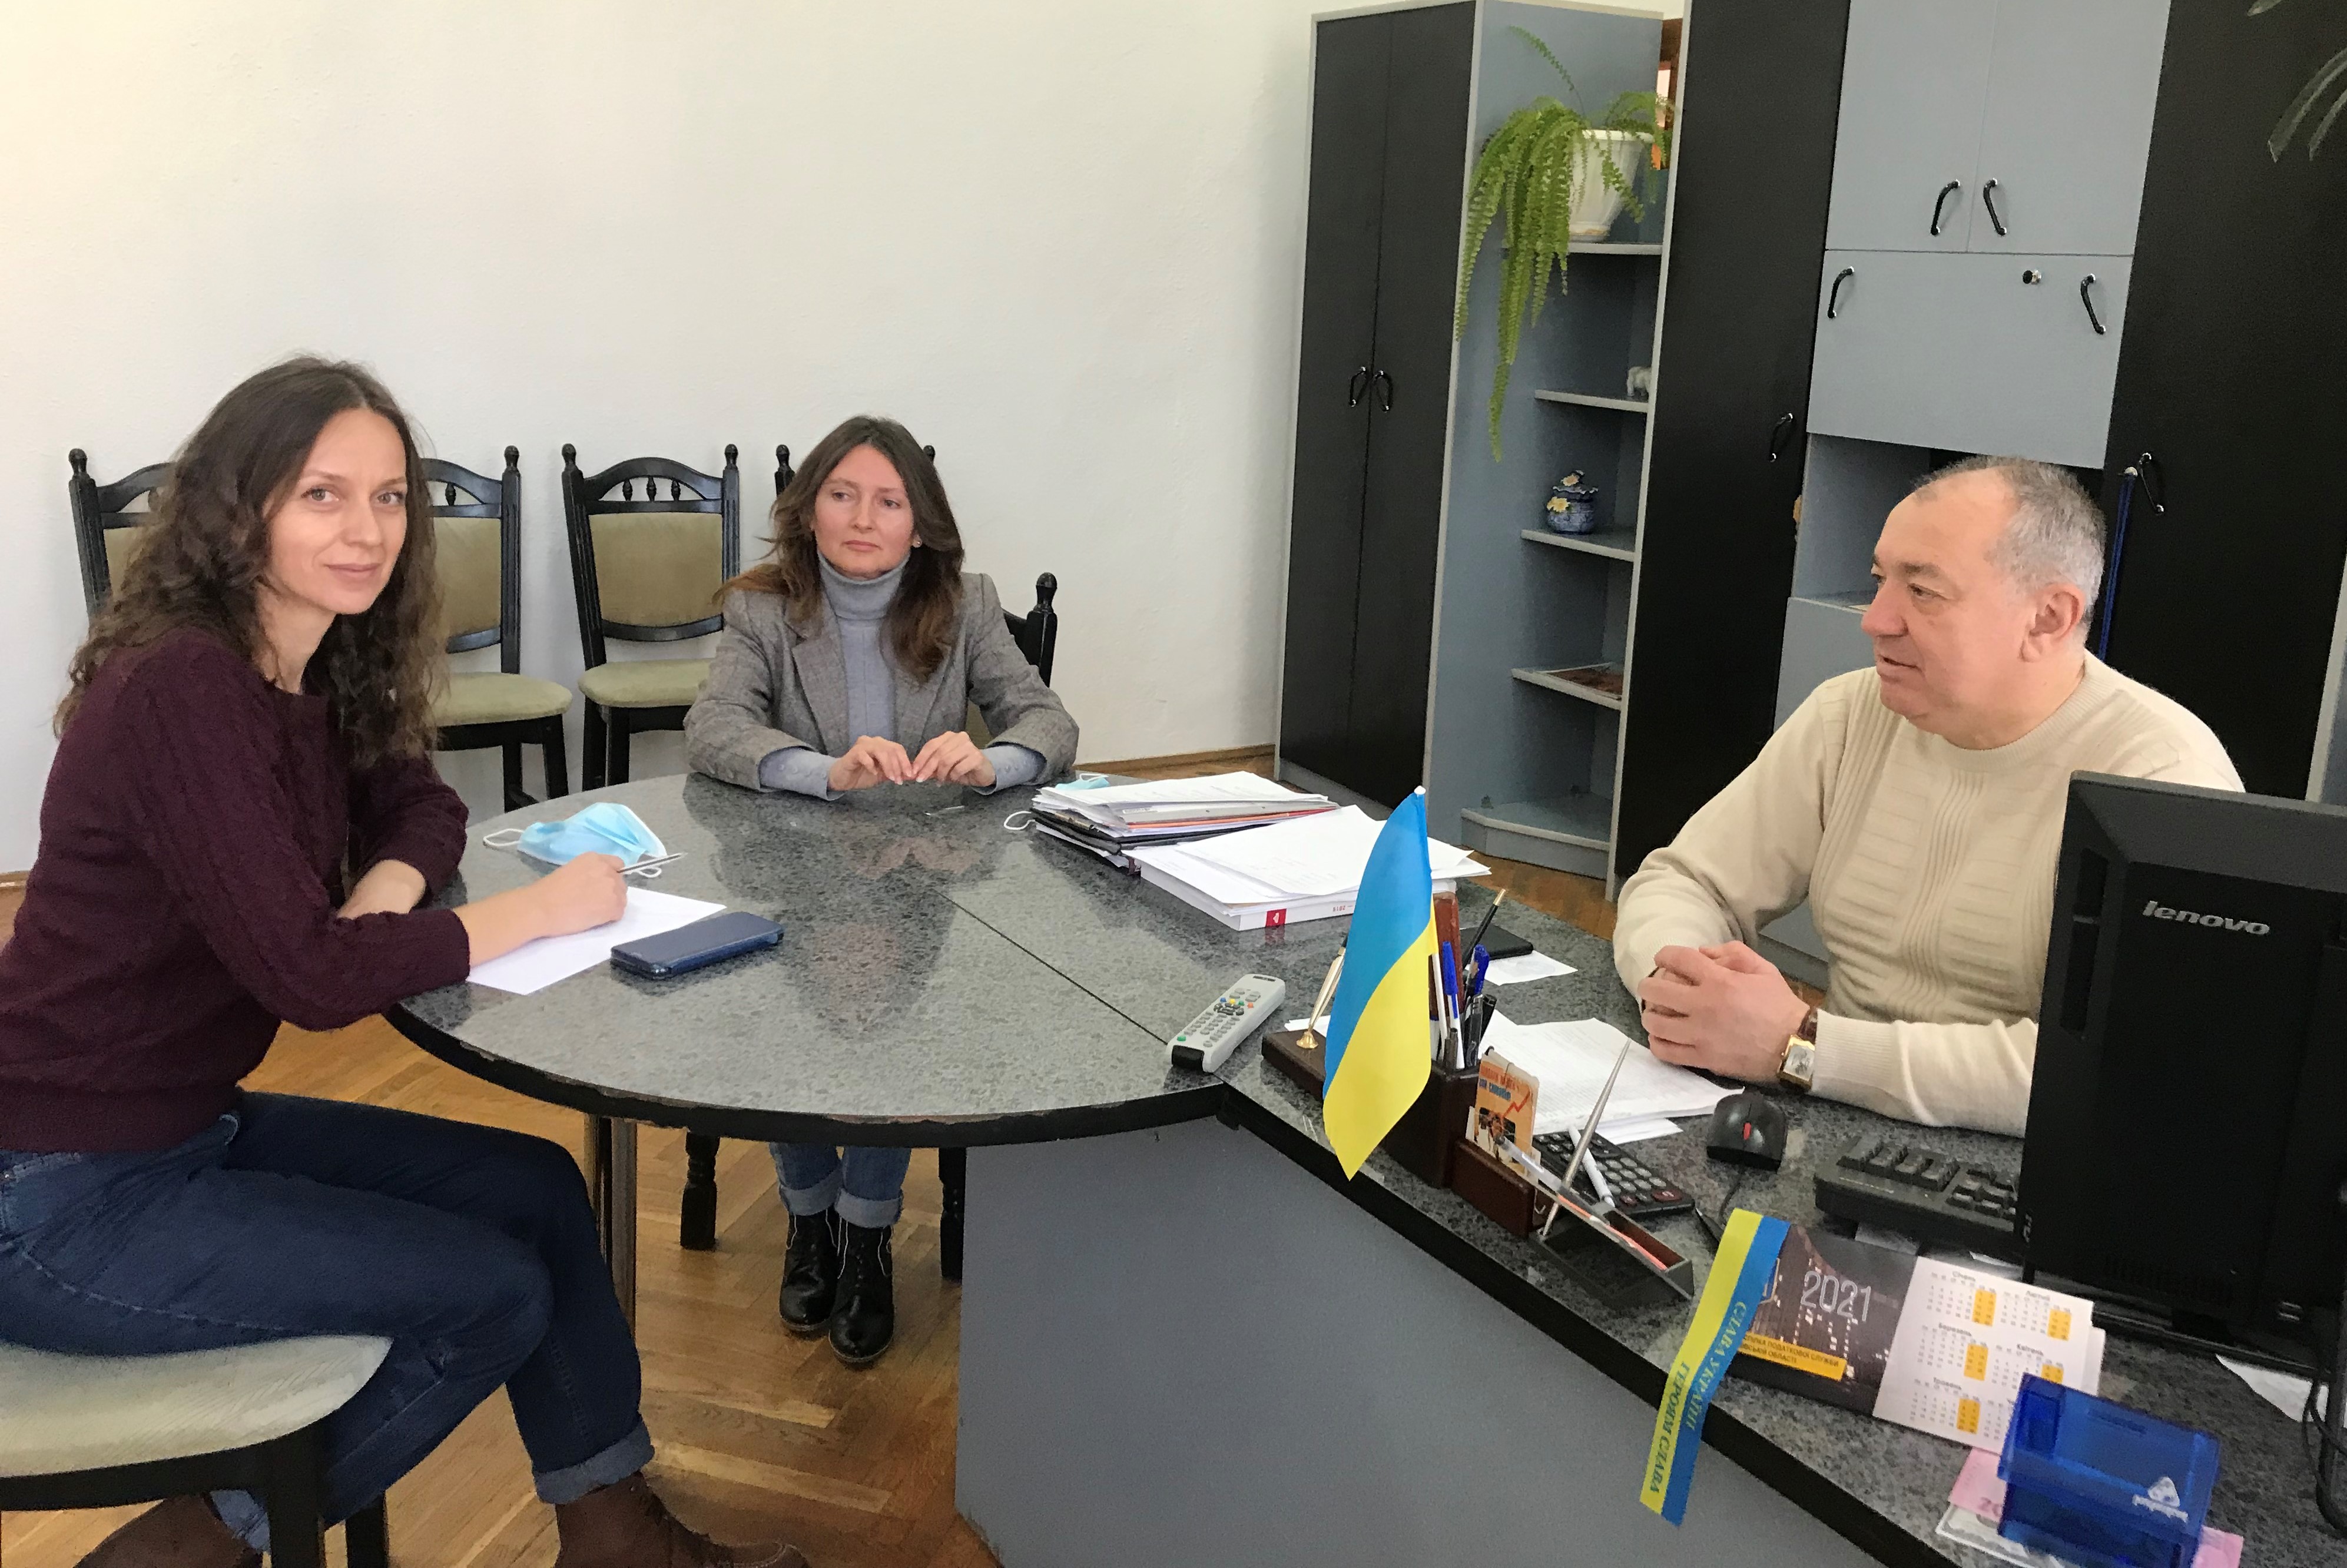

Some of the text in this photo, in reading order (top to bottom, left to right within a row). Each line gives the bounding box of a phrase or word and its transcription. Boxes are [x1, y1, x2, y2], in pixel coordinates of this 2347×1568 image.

[2143, 900, 2270, 935] lenovo
[1801, 1271, 1871, 1322] 2021
[1715, 1301, 1747, 1356] СЛАВА
[1650, 1361, 1690, 1494] ГЕРОЯМ СЛАВА
